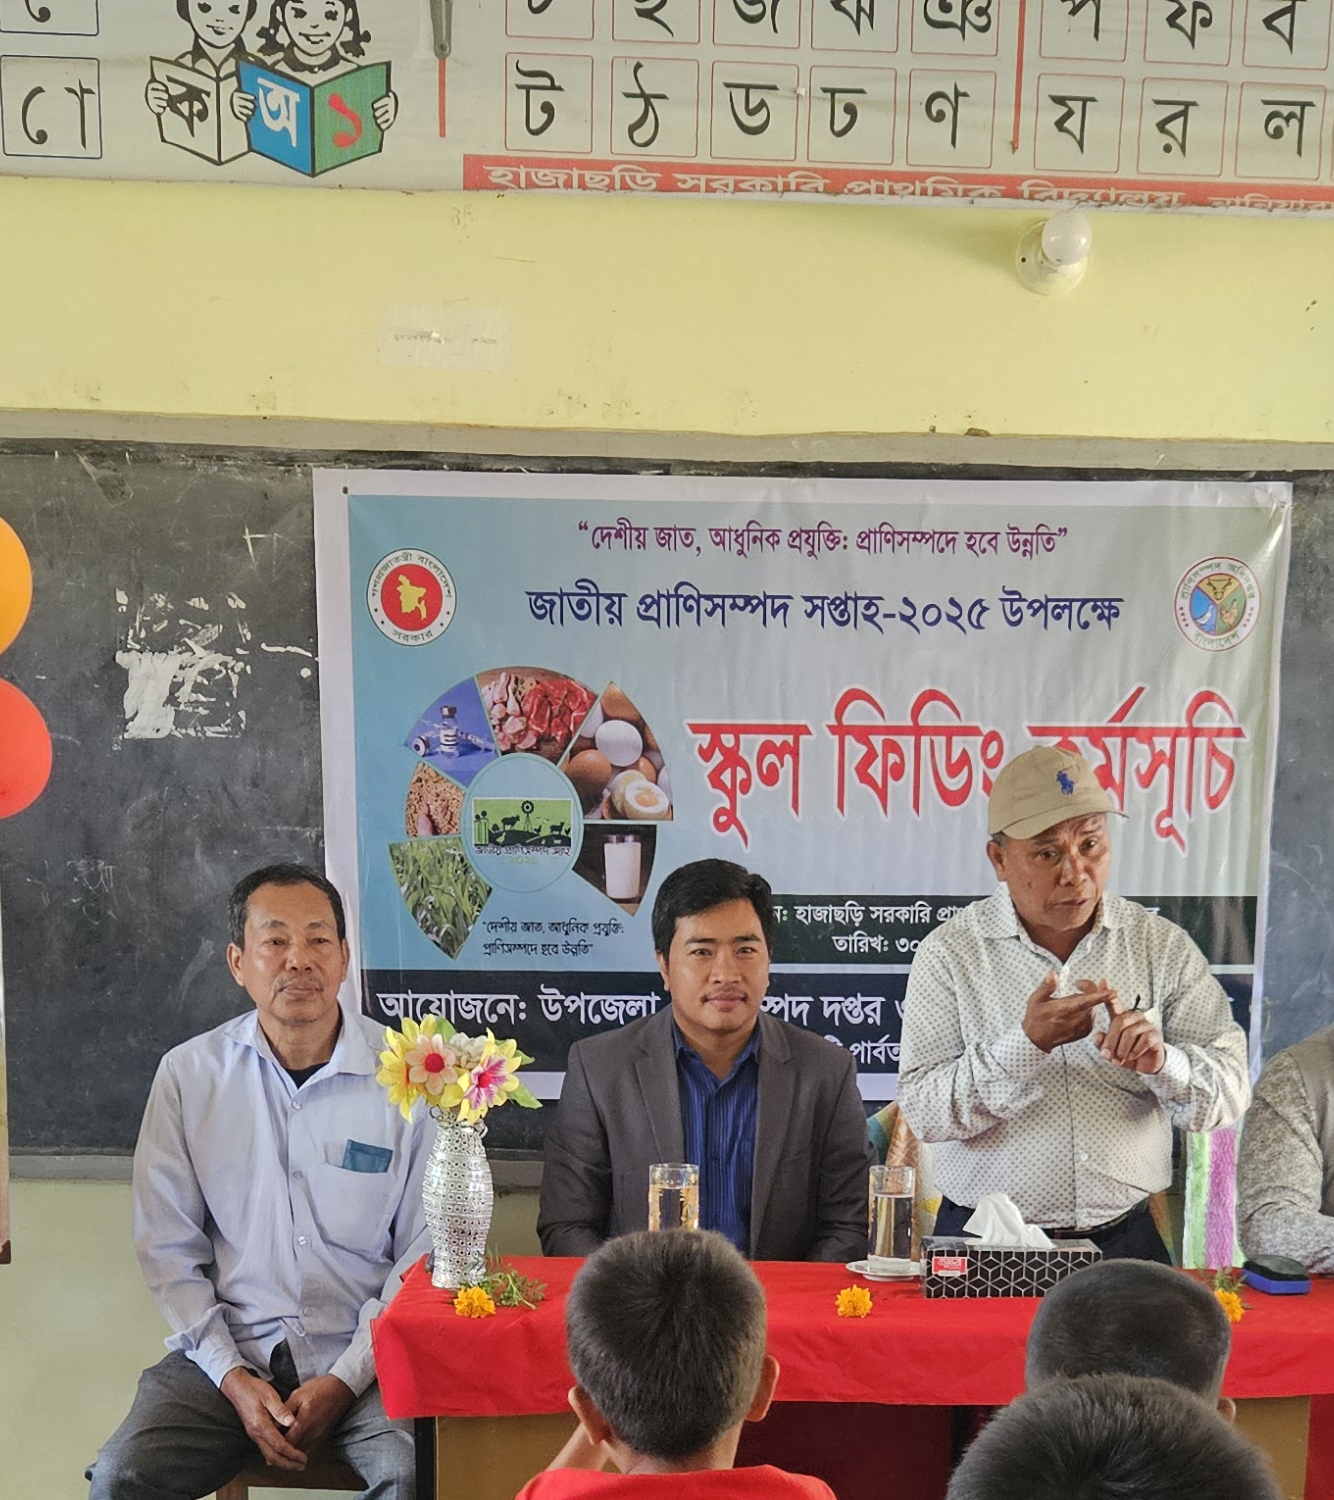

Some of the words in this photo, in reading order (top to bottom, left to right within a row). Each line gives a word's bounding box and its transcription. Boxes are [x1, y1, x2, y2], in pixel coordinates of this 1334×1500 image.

[1165, 0, 1213, 49] ফ
[1261, 0, 1304, 54] ব
[167, 75, 211, 138] ক
[255, 77, 301, 148] অ
[328, 92, 363, 148] ১
[515, 60, 564, 136] ট
[622, 61, 669, 147] ঠ
[723, 82, 779, 135] ড
[820, 87, 867, 137] ঢ
[925, 82, 970, 148] ণ
[1049, 95, 1098, 153] য
[1152, 99, 1199, 157] র
[1261, 100, 1315, 157] ল
[655, 525, 702, 557] জাত,
[710, 520, 781, 559] আধুনিক
[856, 521, 959, 555] প্রাণিসম্পদে
[966, 527, 1001, 556] হবে
[526, 578, 628, 630] জাতীয়
[637, 580, 794, 631] প্রাণিসম্পদ
[803, 587, 987, 635] সপ্তাহ-২০২৫
[1001, 585, 1124, 633] উপলক্ষে
[687, 722, 813, 850] স্কুল
[826, 687, 1005, 818] ফিডিং
[548, 917, 590, 937] আধুনিক
[793, 900, 866, 927] হাজাছড়ি
[869, 900, 933, 924] সরকারি
[482, 938, 538, 957] প্রাণিসম্পদে
[541, 943, 559, 957] হবে
[537, 983, 661, 1026] উপজেলা
[819, 992, 886, 1027] দপ্তর
